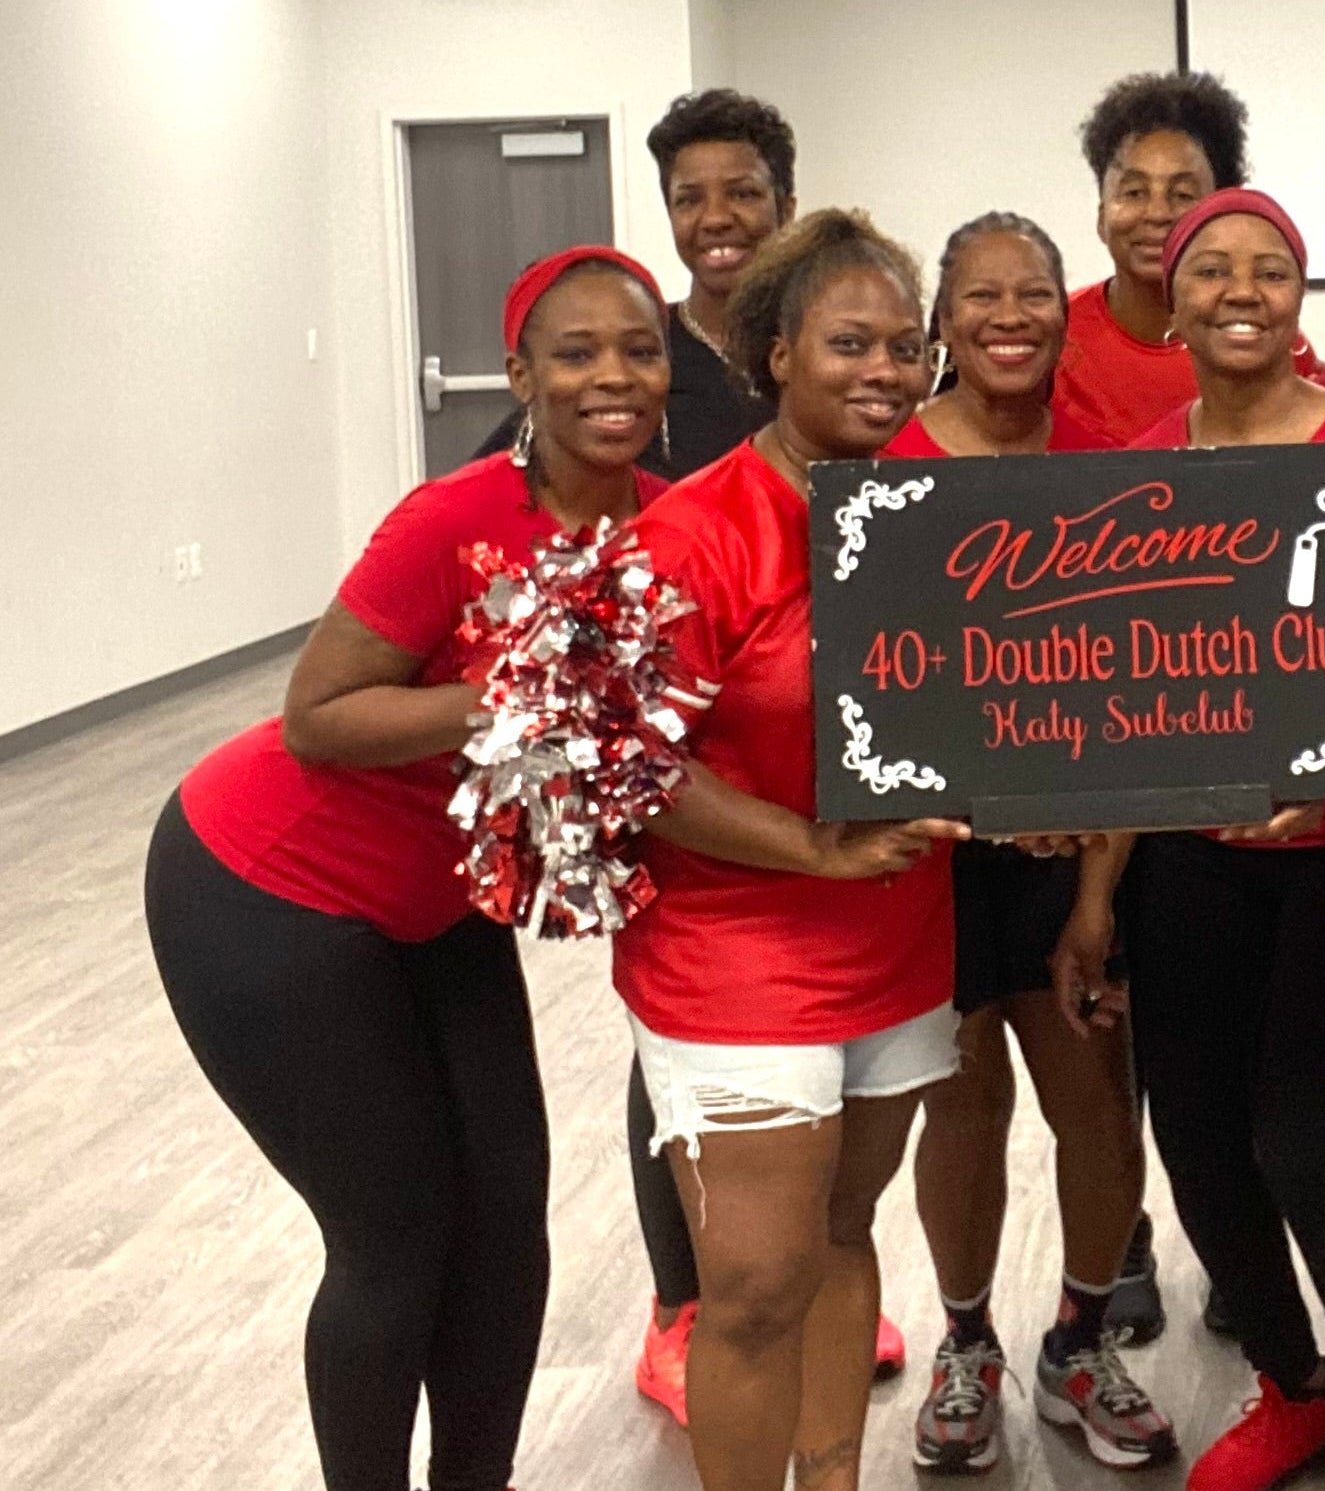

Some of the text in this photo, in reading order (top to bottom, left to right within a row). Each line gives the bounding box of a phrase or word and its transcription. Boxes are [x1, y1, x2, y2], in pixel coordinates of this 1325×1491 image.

[945, 481, 1280, 602] Welcome
[862, 629, 949, 691] 40+
[962, 624, 1116, 688] Double
[1129, 616, 1259, 680] Dutch
[983, 688, 1254, 761] Katy Subclub
